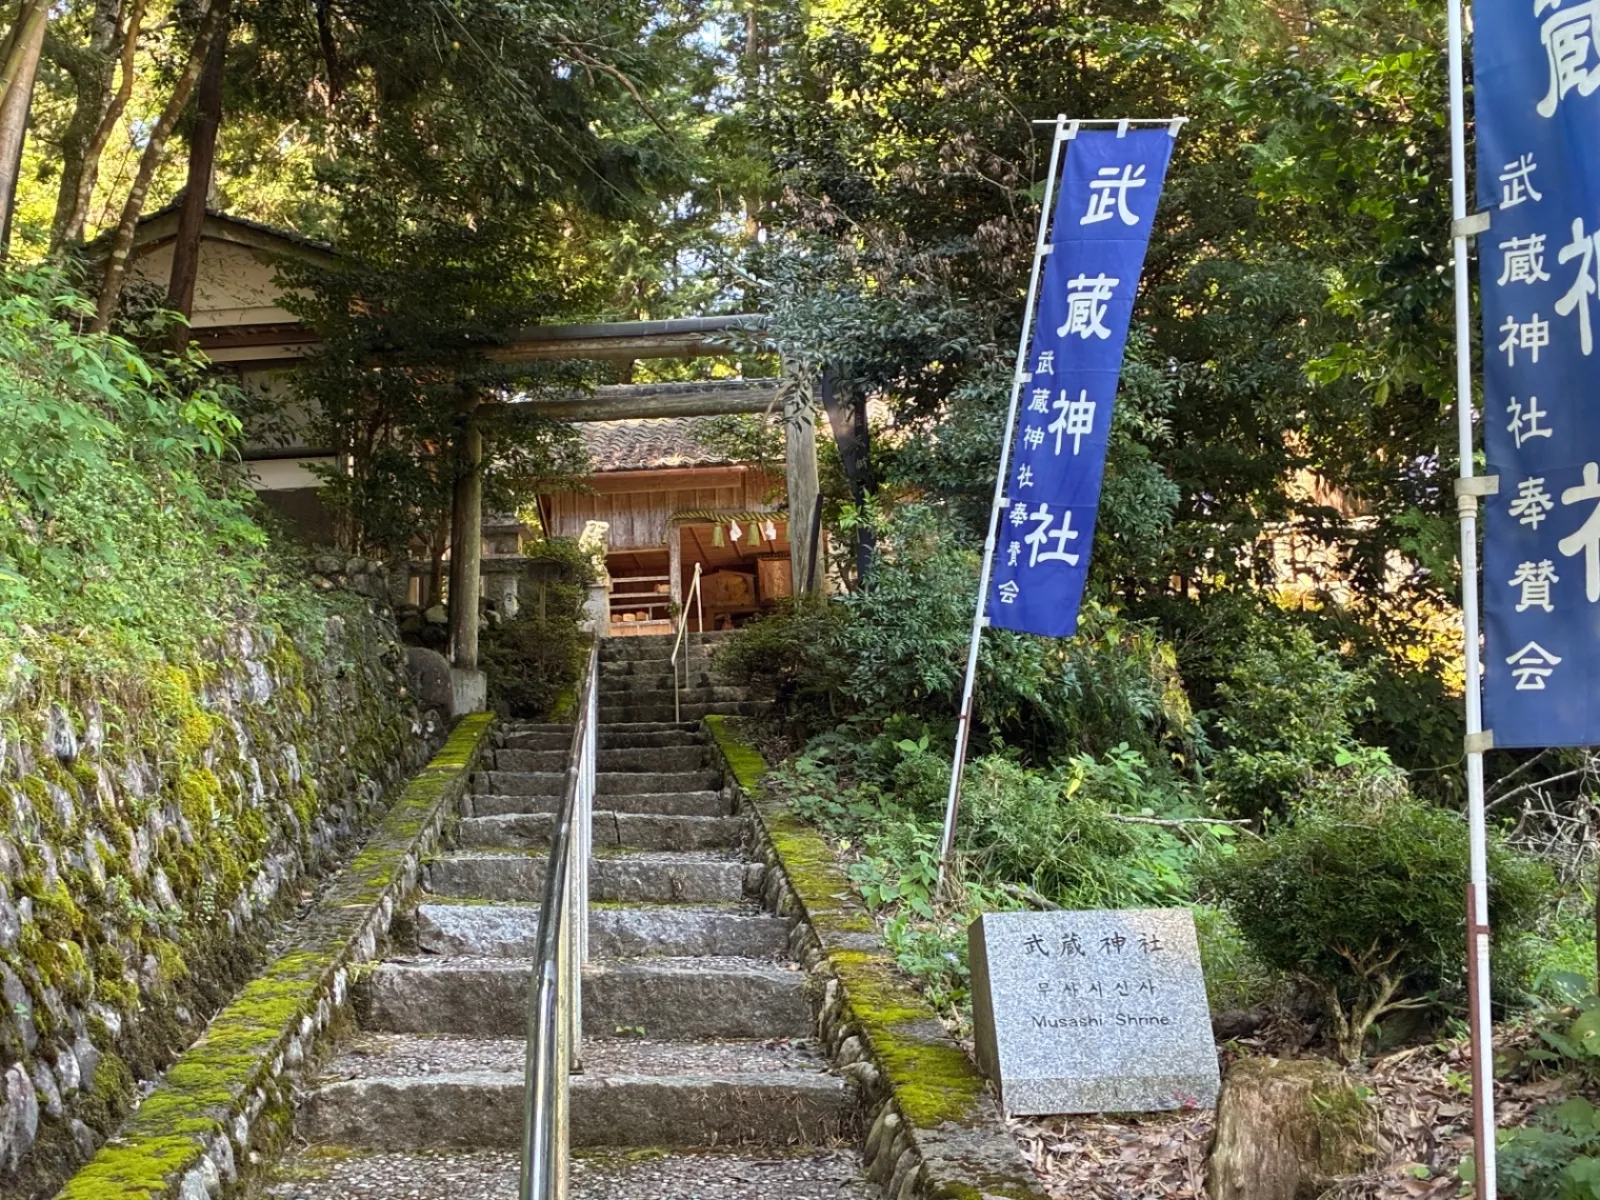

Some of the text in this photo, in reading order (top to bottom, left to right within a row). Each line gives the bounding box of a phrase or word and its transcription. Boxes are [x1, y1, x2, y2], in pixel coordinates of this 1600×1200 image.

[1025, 164, 1146, 568] 武蔵神社
[1498, 152, 1562, 690] 武蔵神社奉賛会
[998, 350, 1055, 604] 武蔵神社奉賛会
[1023, 932, 1164, 957] 武蔵神社
[1037, 979, 1156, 998] 무사시신사
[1032, 1013, 1170, 1028] Musashi Shrine
